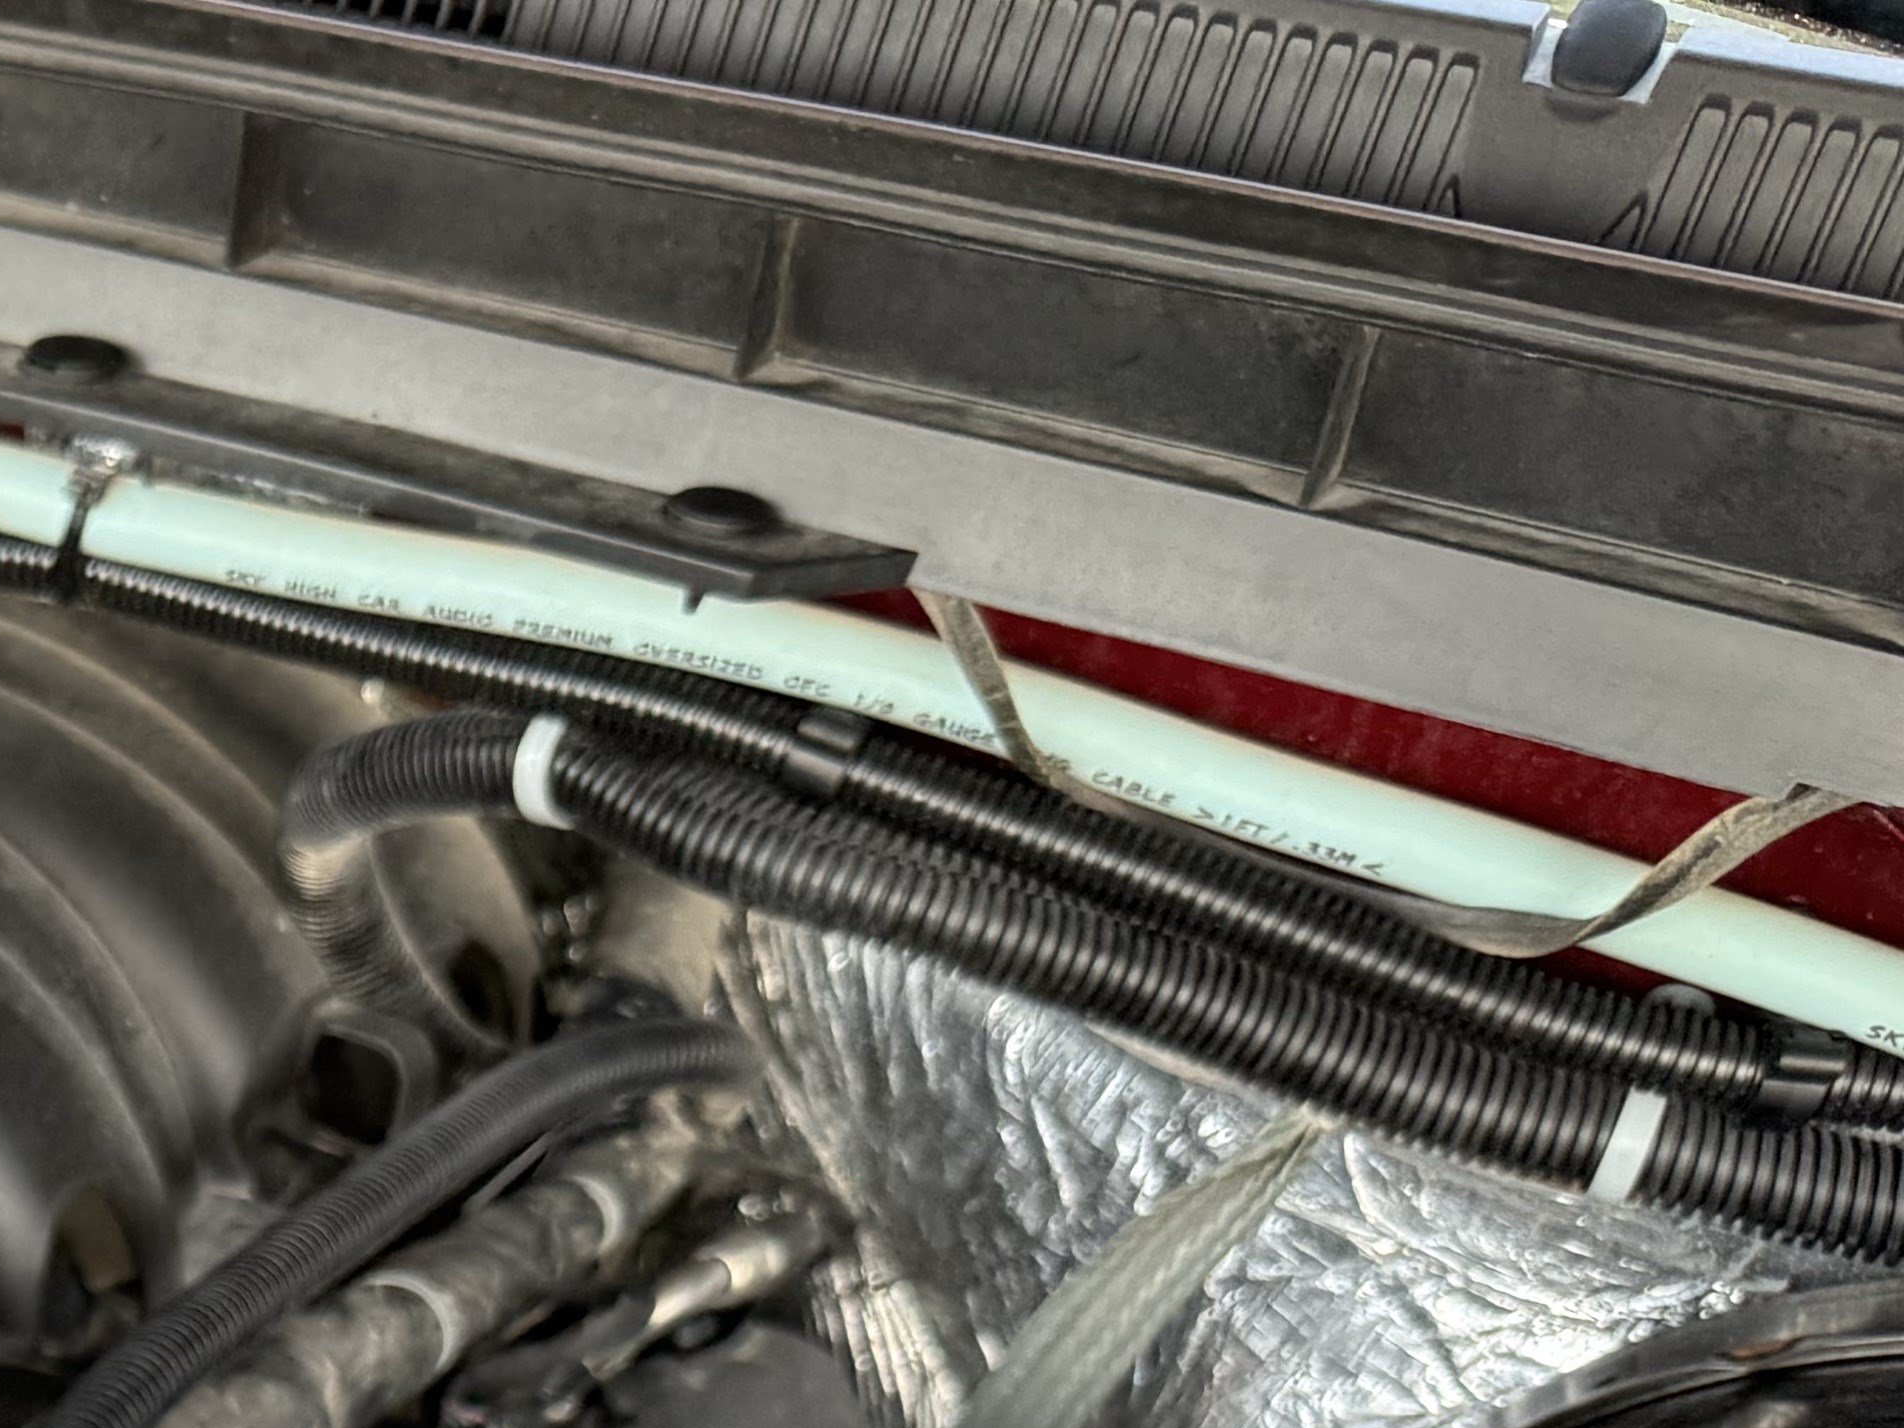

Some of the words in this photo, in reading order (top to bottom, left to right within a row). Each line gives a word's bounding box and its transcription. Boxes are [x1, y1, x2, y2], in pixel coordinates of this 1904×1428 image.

[285, 579, 337, 598] HIGH
[358, 594, 401, 613] CAR
[423, 605, 493, 627] AUDIO
[512, 618, 613, 647] PREMIUM
[633, 642, 765, 679] OVERSIZED
[1092, 771, 1176, 805] CABLE
